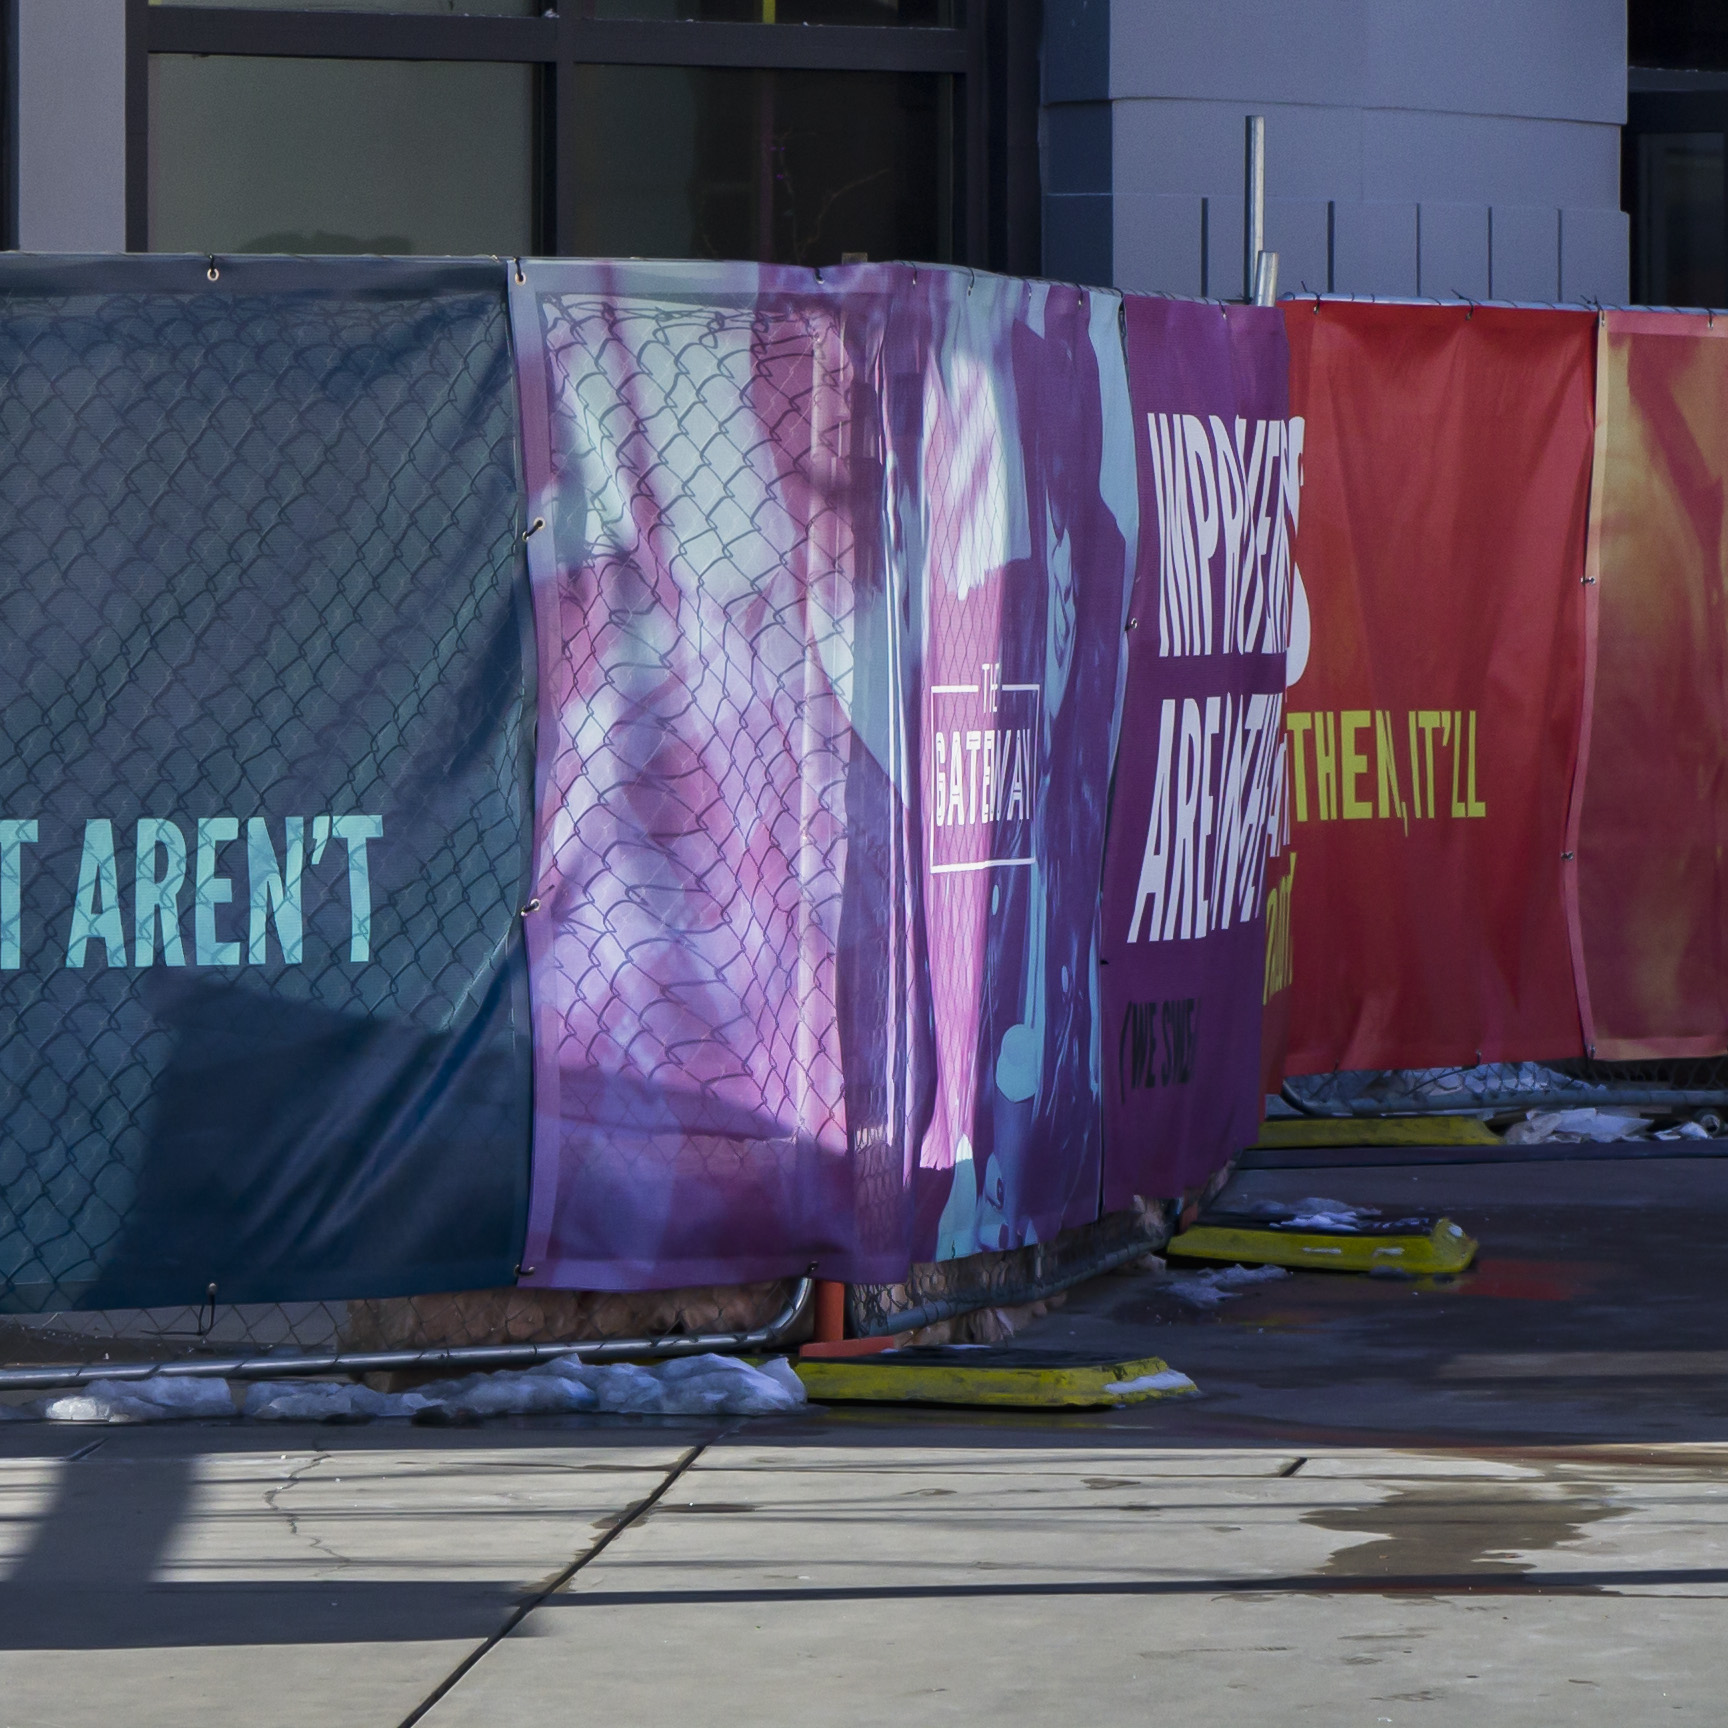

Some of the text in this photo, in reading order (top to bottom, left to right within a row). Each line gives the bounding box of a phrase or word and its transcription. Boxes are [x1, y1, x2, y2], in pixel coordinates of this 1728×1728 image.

[935, 729, 1031, 827] GATEWAY
[1127, 696, 1221, 943] ARE
[1286, 709, 1409, 838] THEN,
[1408, 709, 1486, 819] IT'LL
[65, 814, 383, 970] AREN'T
